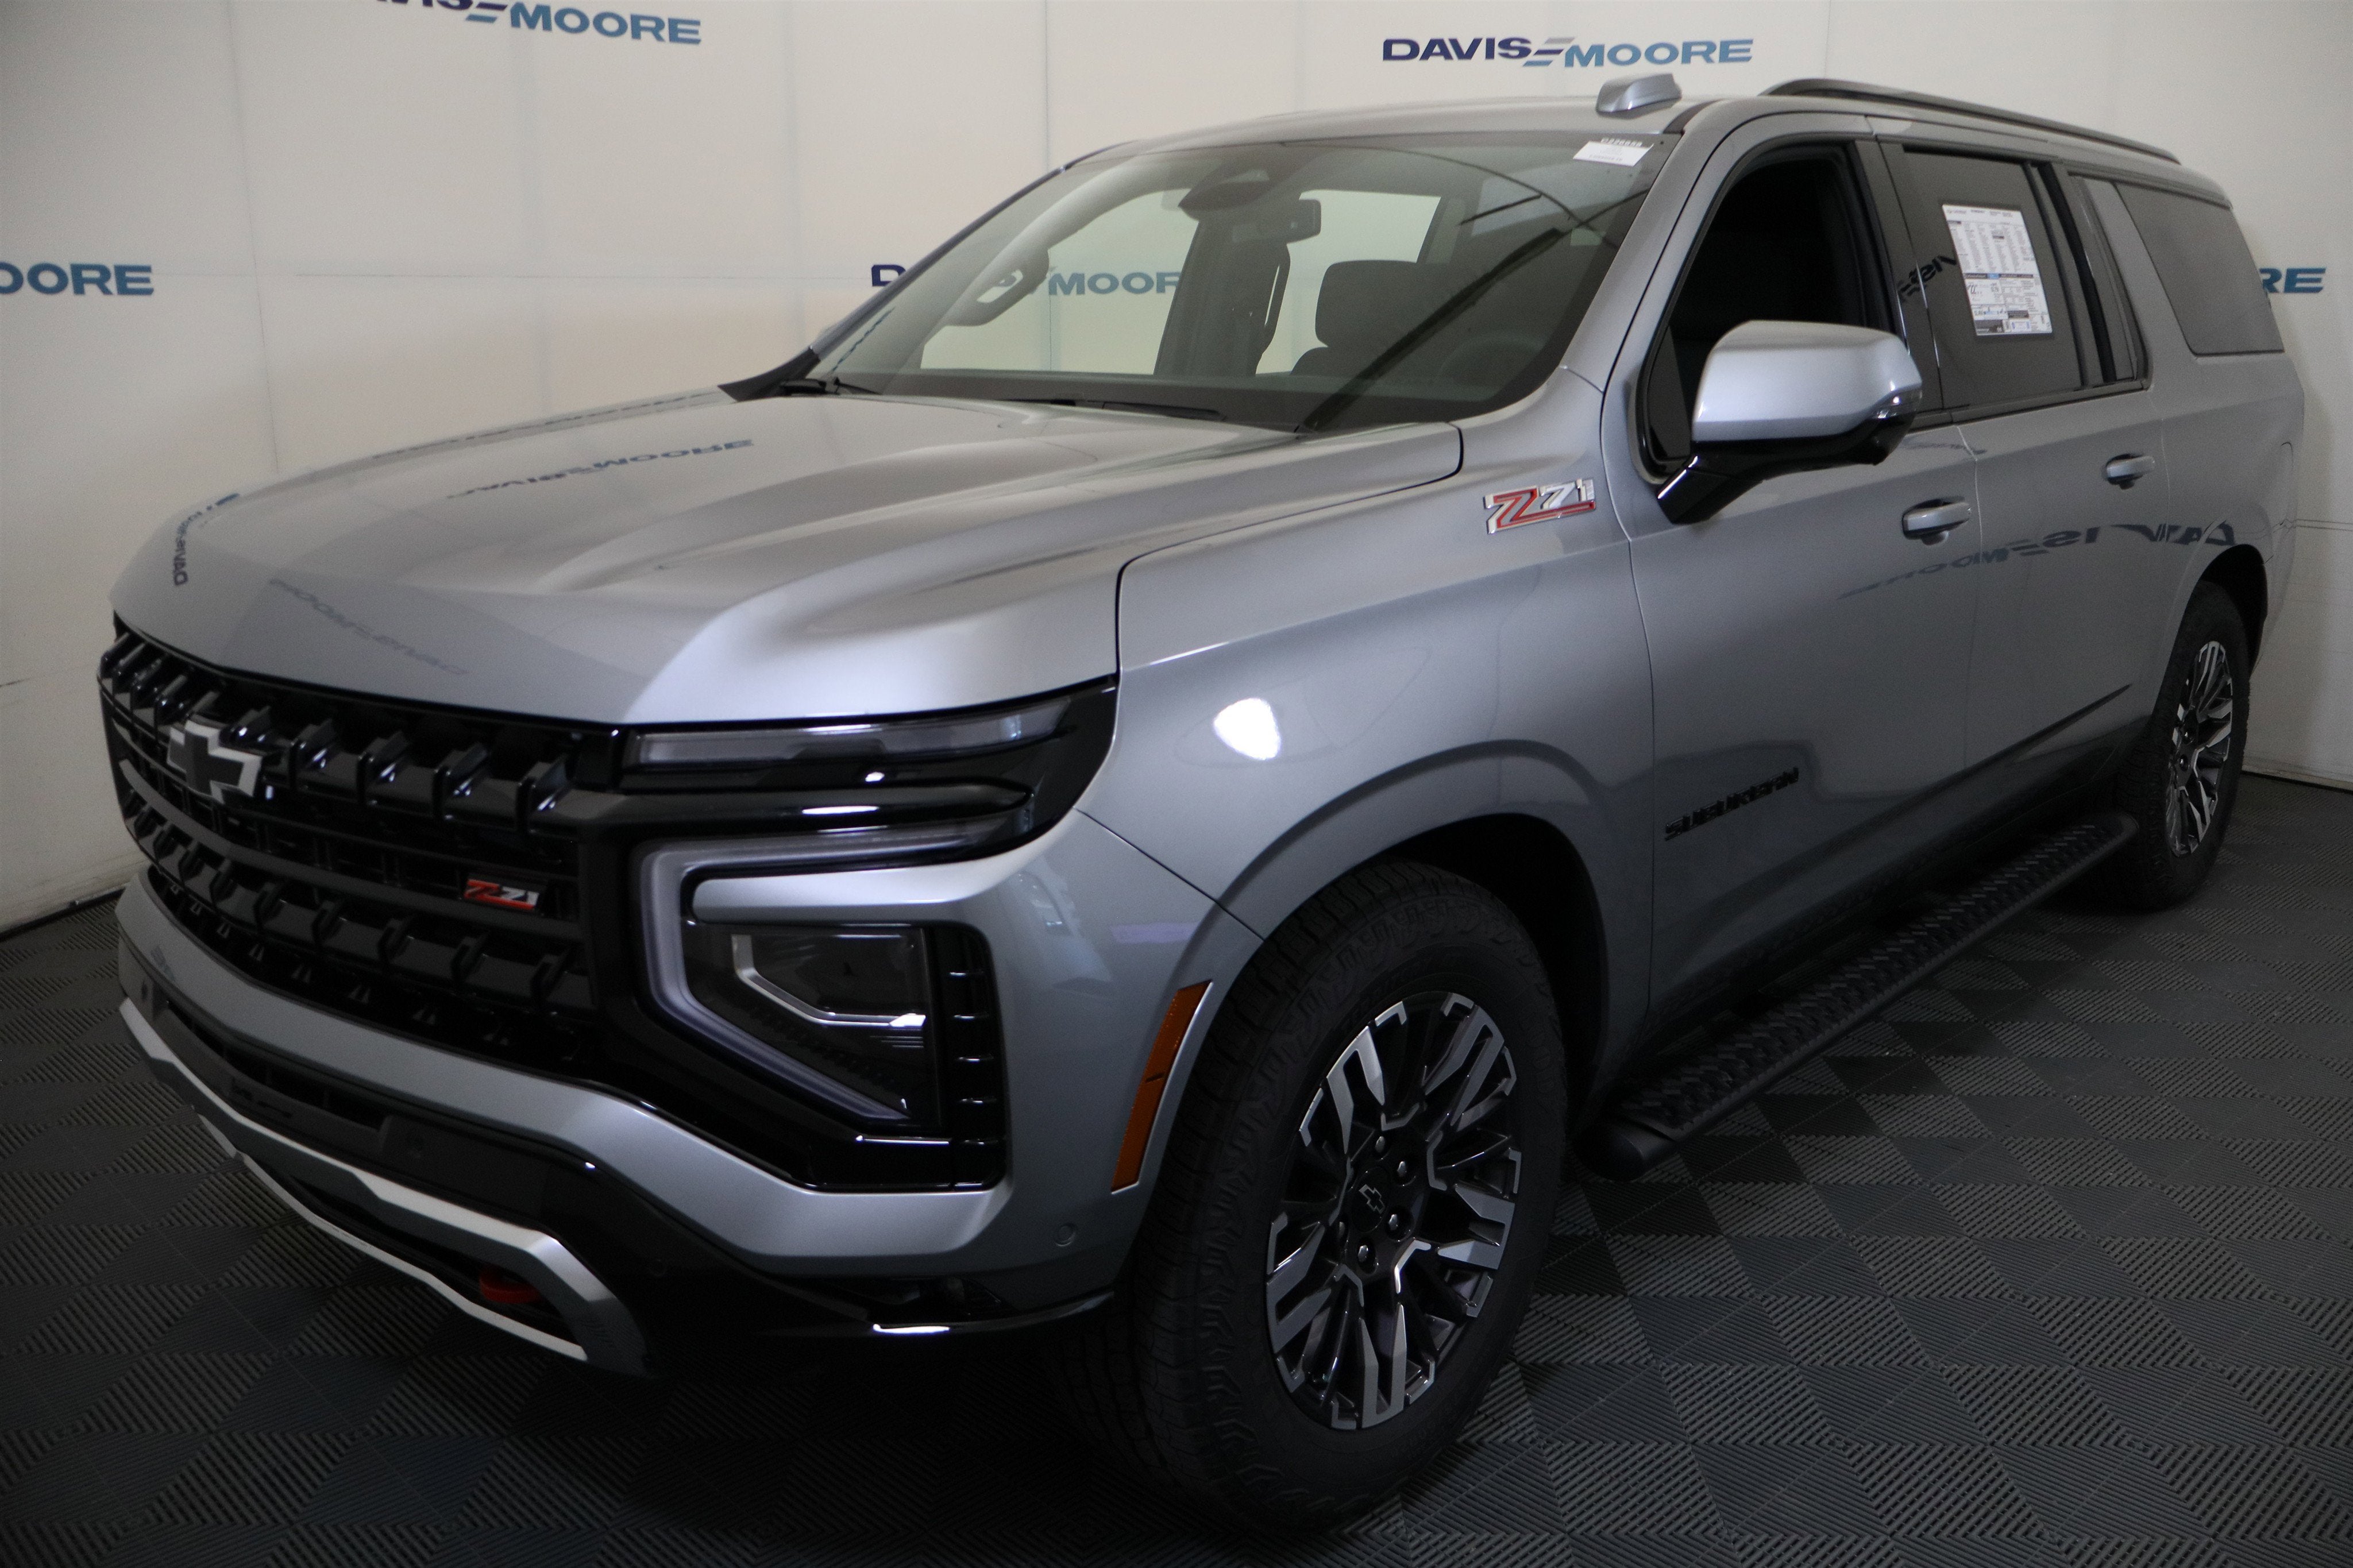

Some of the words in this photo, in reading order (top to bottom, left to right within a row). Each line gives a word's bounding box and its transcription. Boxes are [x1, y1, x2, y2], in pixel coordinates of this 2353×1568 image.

[510, 2, 703, 45] MOORE
[1382, 37, 1533, 62] DAVIS
[1564, 38, 1754, 68] MOORE
[0, 261, 155, 295] OORE
[1048, 271, 1181, 296] MOOR
[1483, 478, 1596, 535] Z71
[463, 878, 540, 911] Z71
